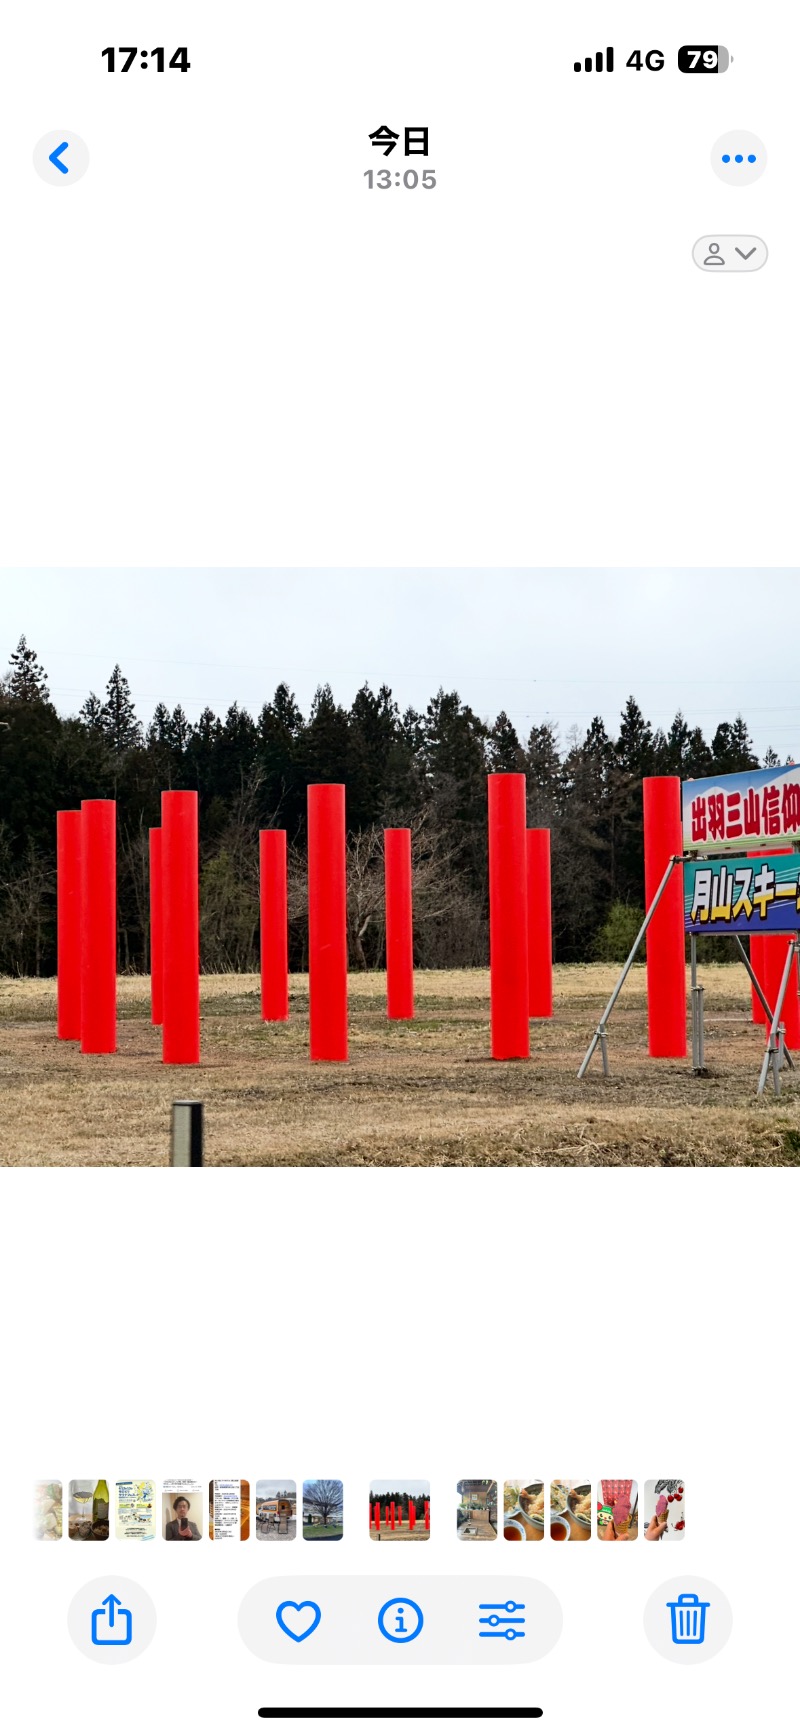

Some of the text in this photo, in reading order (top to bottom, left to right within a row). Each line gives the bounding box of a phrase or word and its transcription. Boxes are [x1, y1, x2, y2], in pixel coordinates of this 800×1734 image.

[102, 47, 191, 73] 17:14
[626, 50, 665, 72] 4G
[687, 51, 718, 69] 79
[368, 126, 429, 157] 今日
[363, 170, 437, 190] 13:05
[690, 863, 800, 924] 月山スキー
